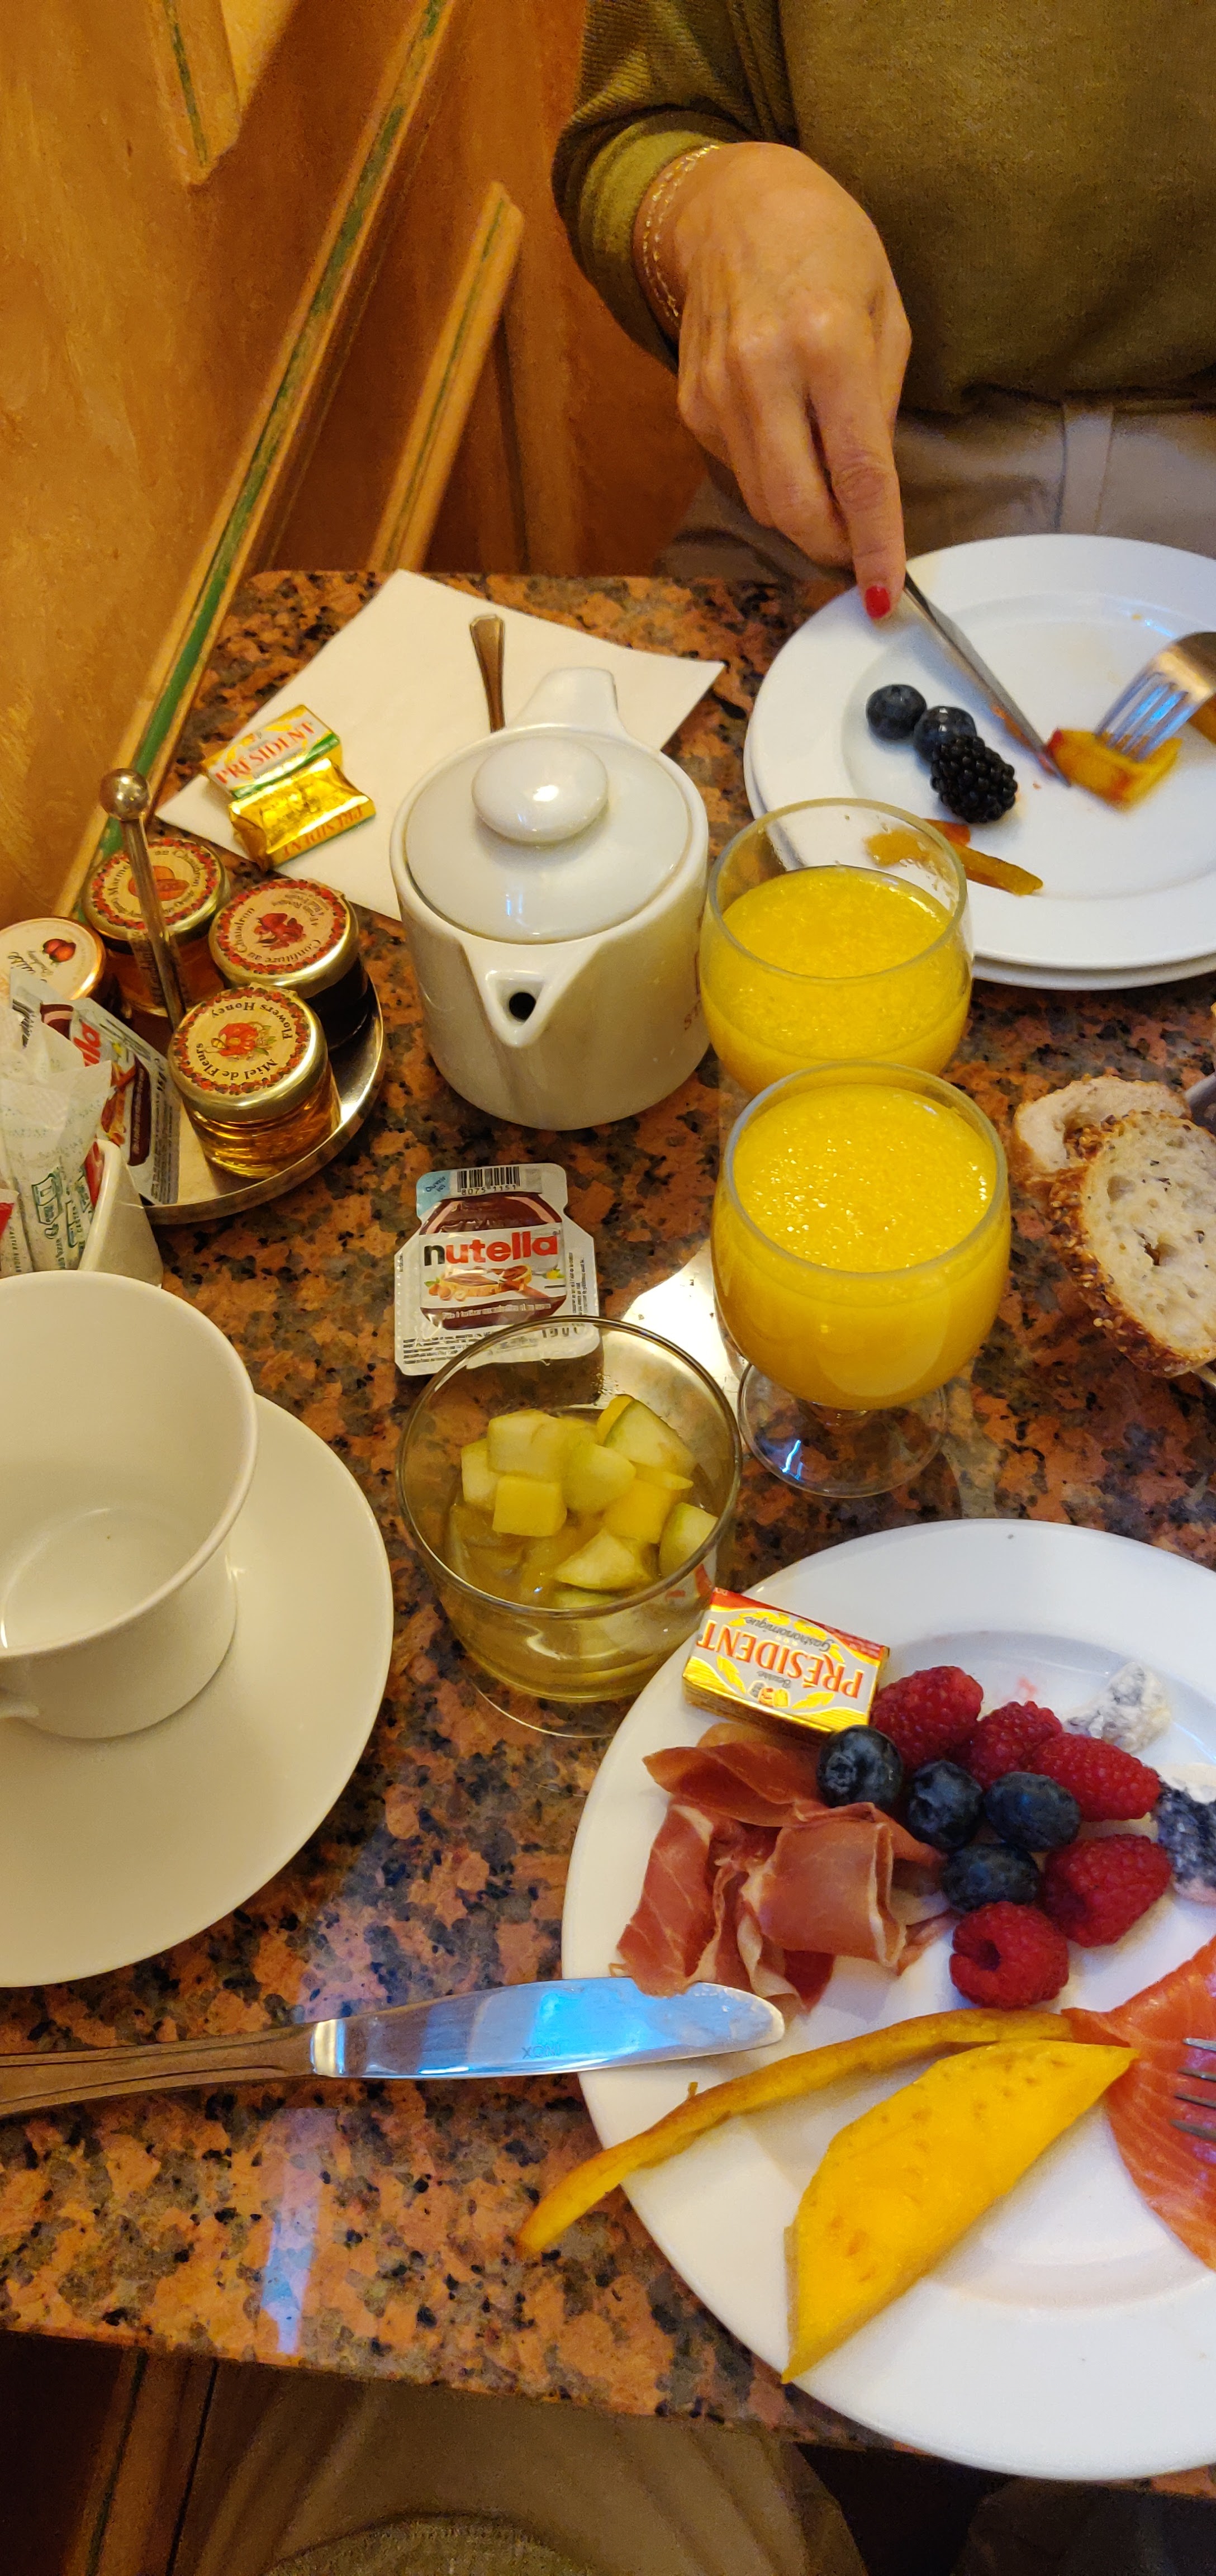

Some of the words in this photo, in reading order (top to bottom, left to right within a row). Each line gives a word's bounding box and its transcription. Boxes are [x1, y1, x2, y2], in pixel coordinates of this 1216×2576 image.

[247, 952, 263, 961] au
[264, 939, 321, 963] Confiture
[211, 1002, 256, 1019] Honey
[259, 1003, 293, 1040] Flowers
[196, 1043, 221, 1077] Fleurs
[243, 1058, 279, 1080] Miel
[221, 1071, 239, 1081] de
[424, 1230, 558, 1266] nutella
[745, 1615, 835, 1652] Gastronomique
[696, 1620, 864, 1699] PRÉSIDENT
[521, 2043, 562, 2060] INOX
